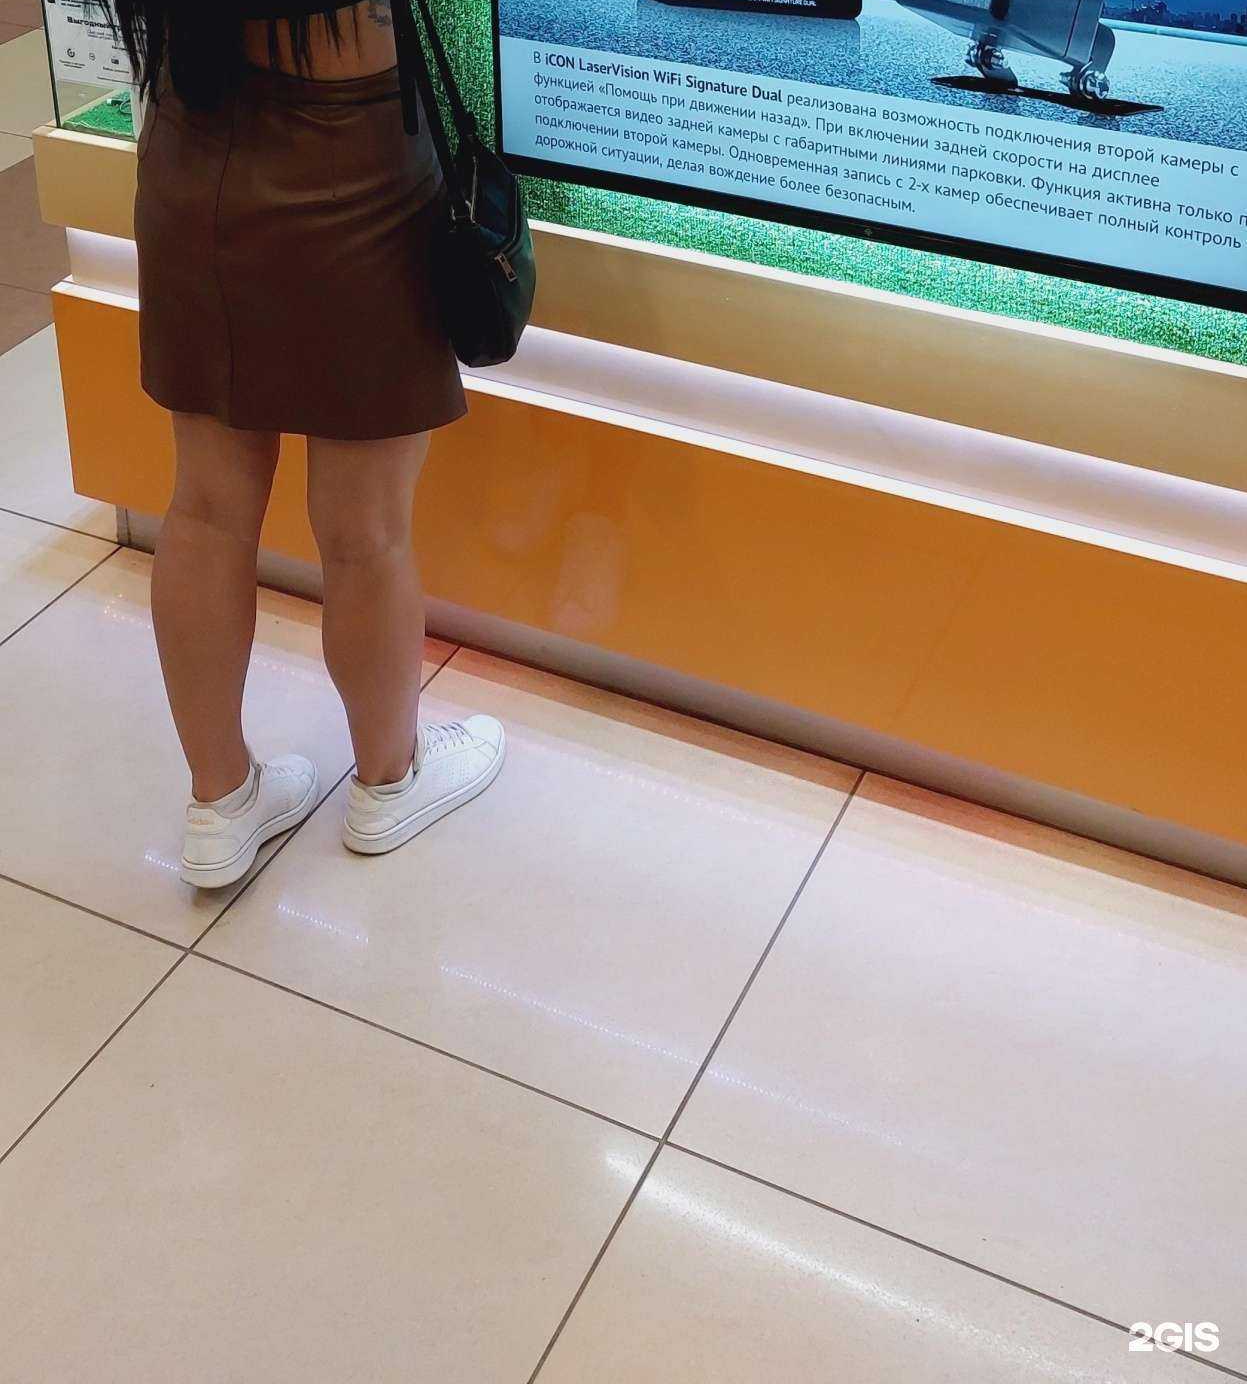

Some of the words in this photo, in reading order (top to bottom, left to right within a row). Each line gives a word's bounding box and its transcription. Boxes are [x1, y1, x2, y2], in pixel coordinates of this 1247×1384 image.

[533, 51, 541, 63] В
[545, 53, 575, 69] iCON
[579, 58, 650, 81] LaserVision
[653, 69, 681, 86] WiFi
[686, 75, 747, 96] Signature
[752, 85, 782, 102] Dual
[787, 94, 877, 118] реализована
[883, 109, 980, 135] возможность
[986, 126, 1091, 152] подключения
[1097, 144, 1154, 163] второй
[1161, 153, 1224, 174] камеры
[1231, 165, 1239, 176] с
[533, 72, 594, 93] функцией
[599, 83, 658, 103] «Помощь
[662, 95, 685, 109] при
[690, 100, 756, 119] движении
[761, 111, 811, 129] назад».
[816, 117, 843, 135] При
[849, 126, 929, 149] включении
[934, 139, 987, 159] задней
[993, 150, 1062, 172] скорости
[1069, 162, 1087, 175] на
[1092, 167, 1160, 187] дисплее
[534, 94, 621, 118] отображается
[625, 109, 663, 125] видео
[667, 118, 713, 134] задней
[718, 125, 768, 143] камеры
[773, 134, 781, 145] с
[785, 137, 878, 162] габаритными
[882, 154, 946, 174] линиями
[952, 165, 1026, 188] парковки.
[1031, 176, 1101, 201] Функция
[1107, 192, 1171, 213] активна
[1177, 204, 1233, 223] только
[535, 134, 597, 154] дорожной
[601, 146, 663, 167] ситуации,
[666, 158, 704, 173] делая
[709, 165, 775, 187] вождение
[779, 175, 821, 195] более
[825, 185, 916, 213] безопасным.
[535, 115, 619, 138] подключении
[624, 131, 668, 147] второй
[672, 138, 725, 156] камеры.
[729, 145, 838, 177] Одновременная
[843, 168, 891, 188] запись
[896, 177, 903, 188] с
[909, 177, 930, 193] 2-х
[935, 185, 980, 204] камер
[985, 193, 1093, 222] обеспечивает
[1098, 213, 1159, 234] полный
[1165, 225, 1242, 249] контроль
